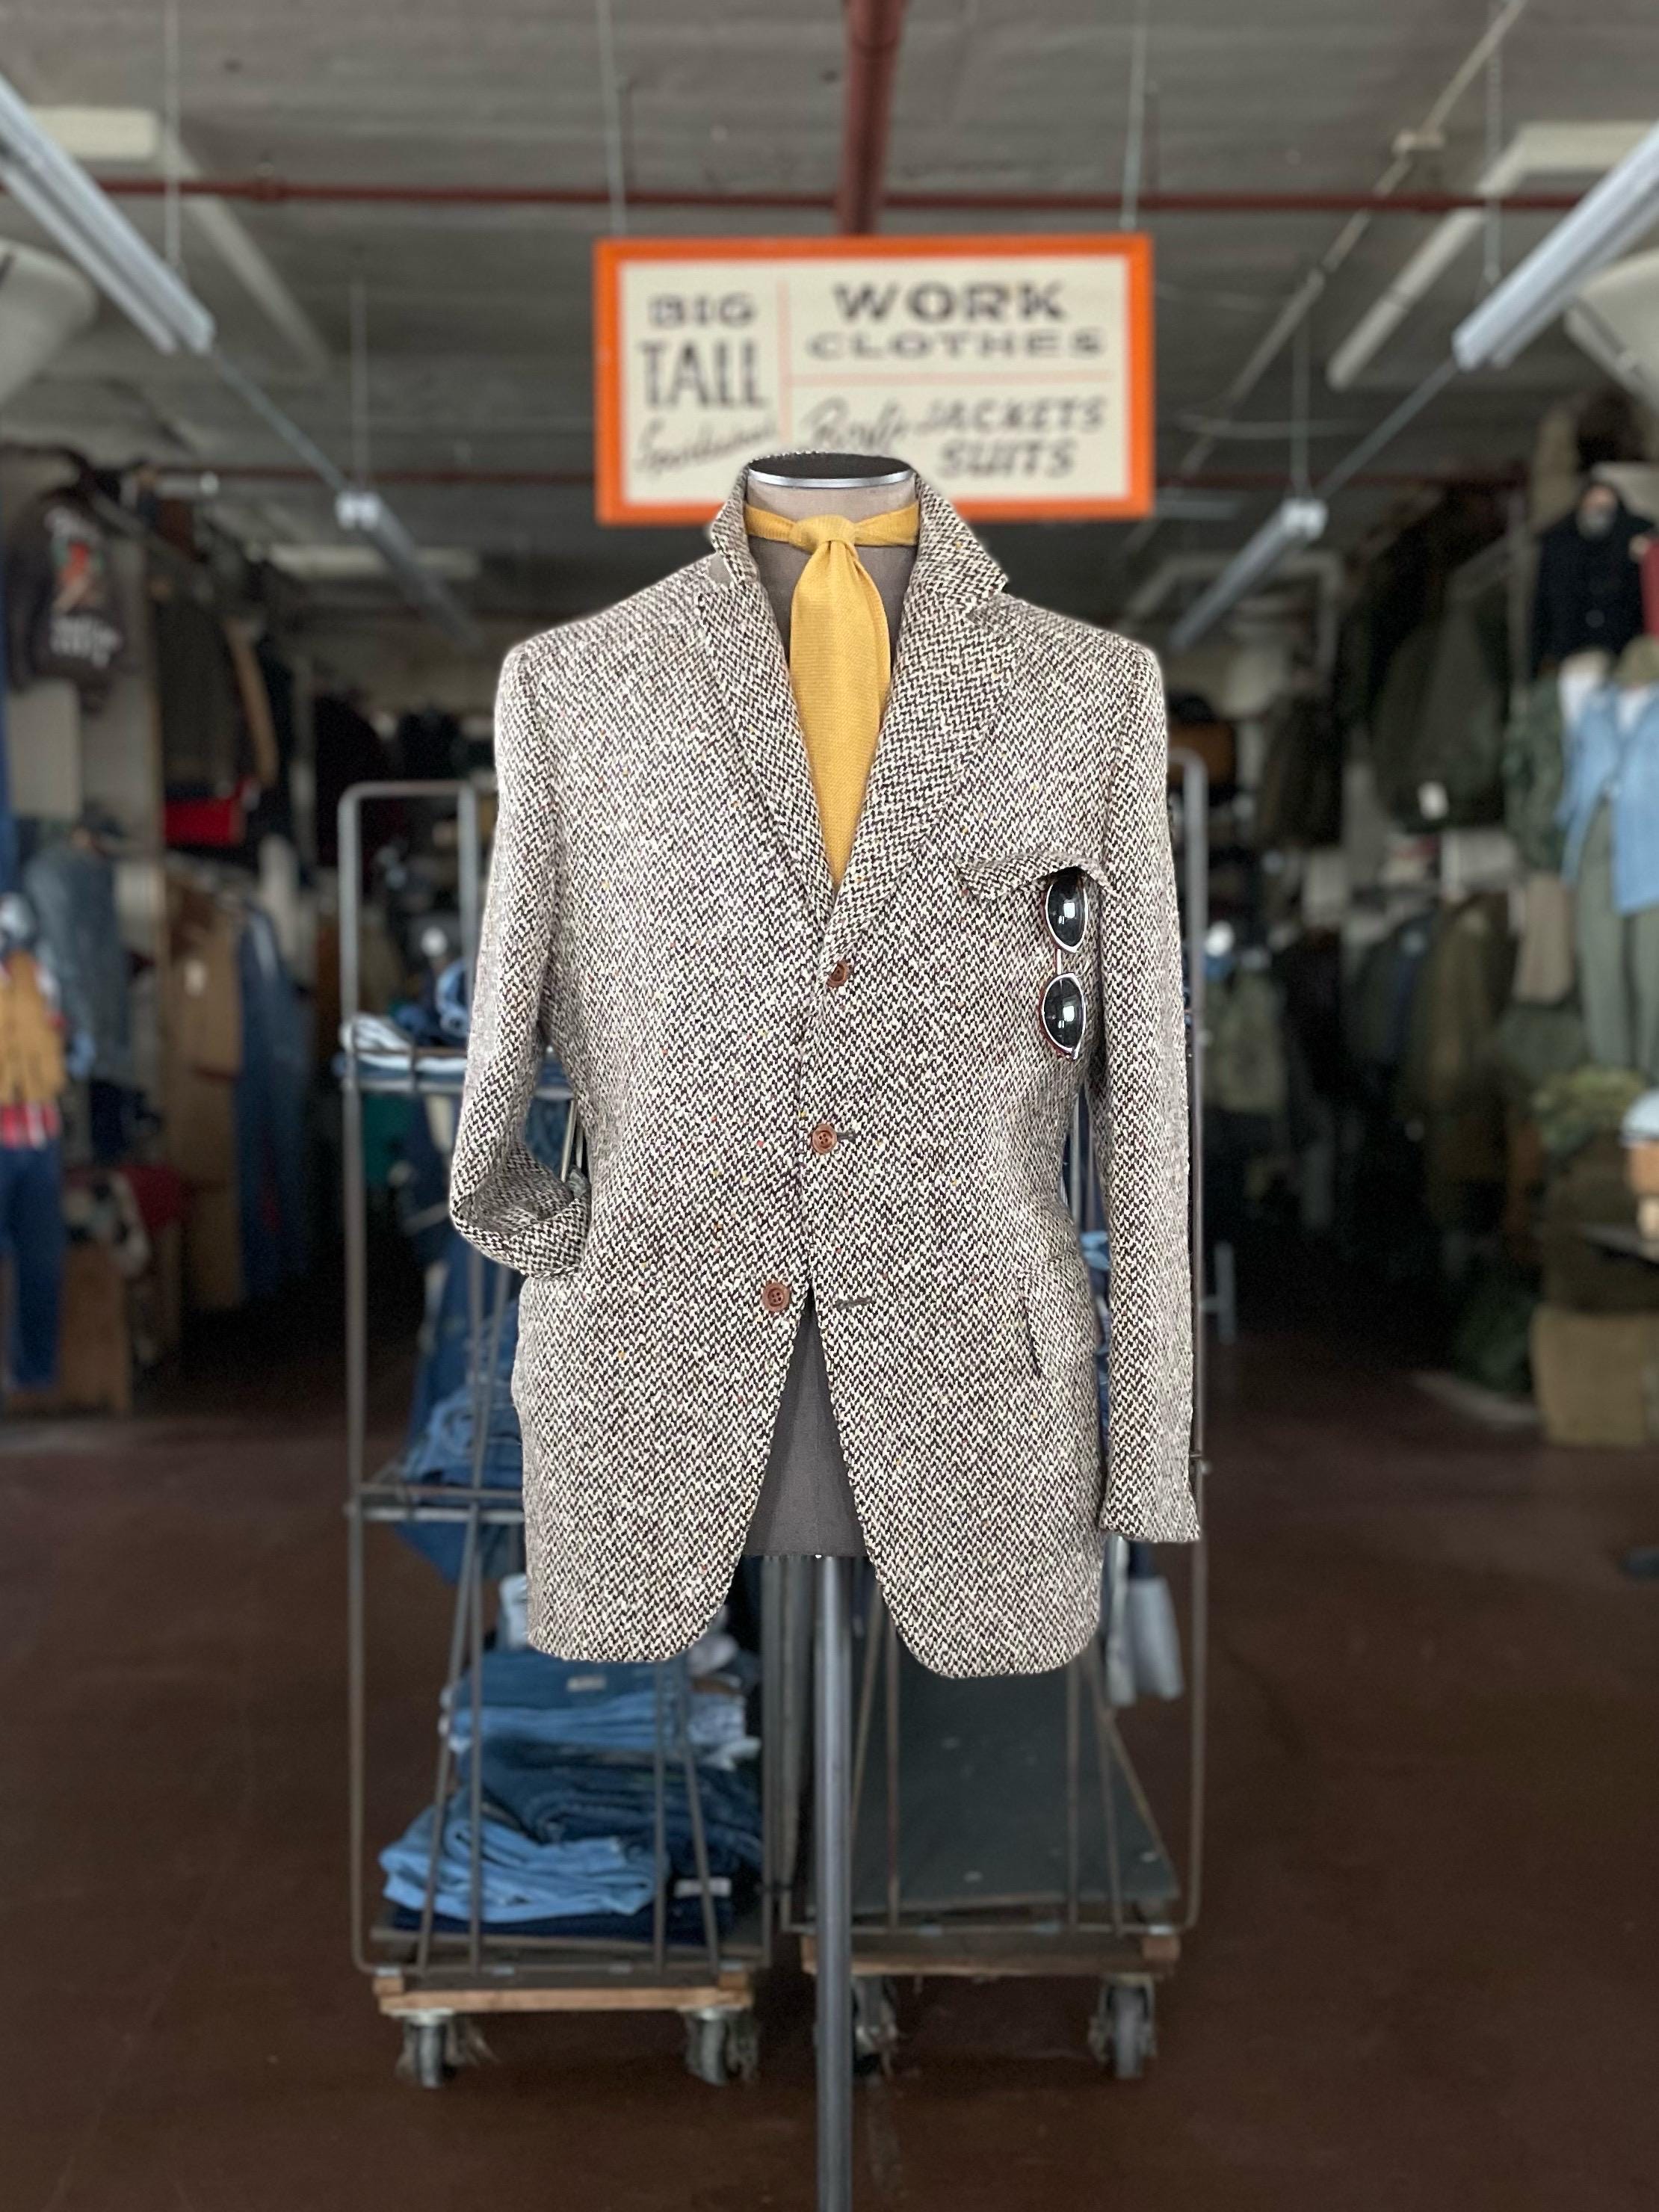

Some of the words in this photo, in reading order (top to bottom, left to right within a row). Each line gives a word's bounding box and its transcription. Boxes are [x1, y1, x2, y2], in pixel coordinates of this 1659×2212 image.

[648, 291, 757, 329] BIG
[832, 281, 1067, 323] WORK
[806, 327, 1105, 360] CLOTHES
[638, 339, 771, 408] TALL
[915, 395, 1107, 435] JACKETS
[936, 436, 1076, 478] SUITS
